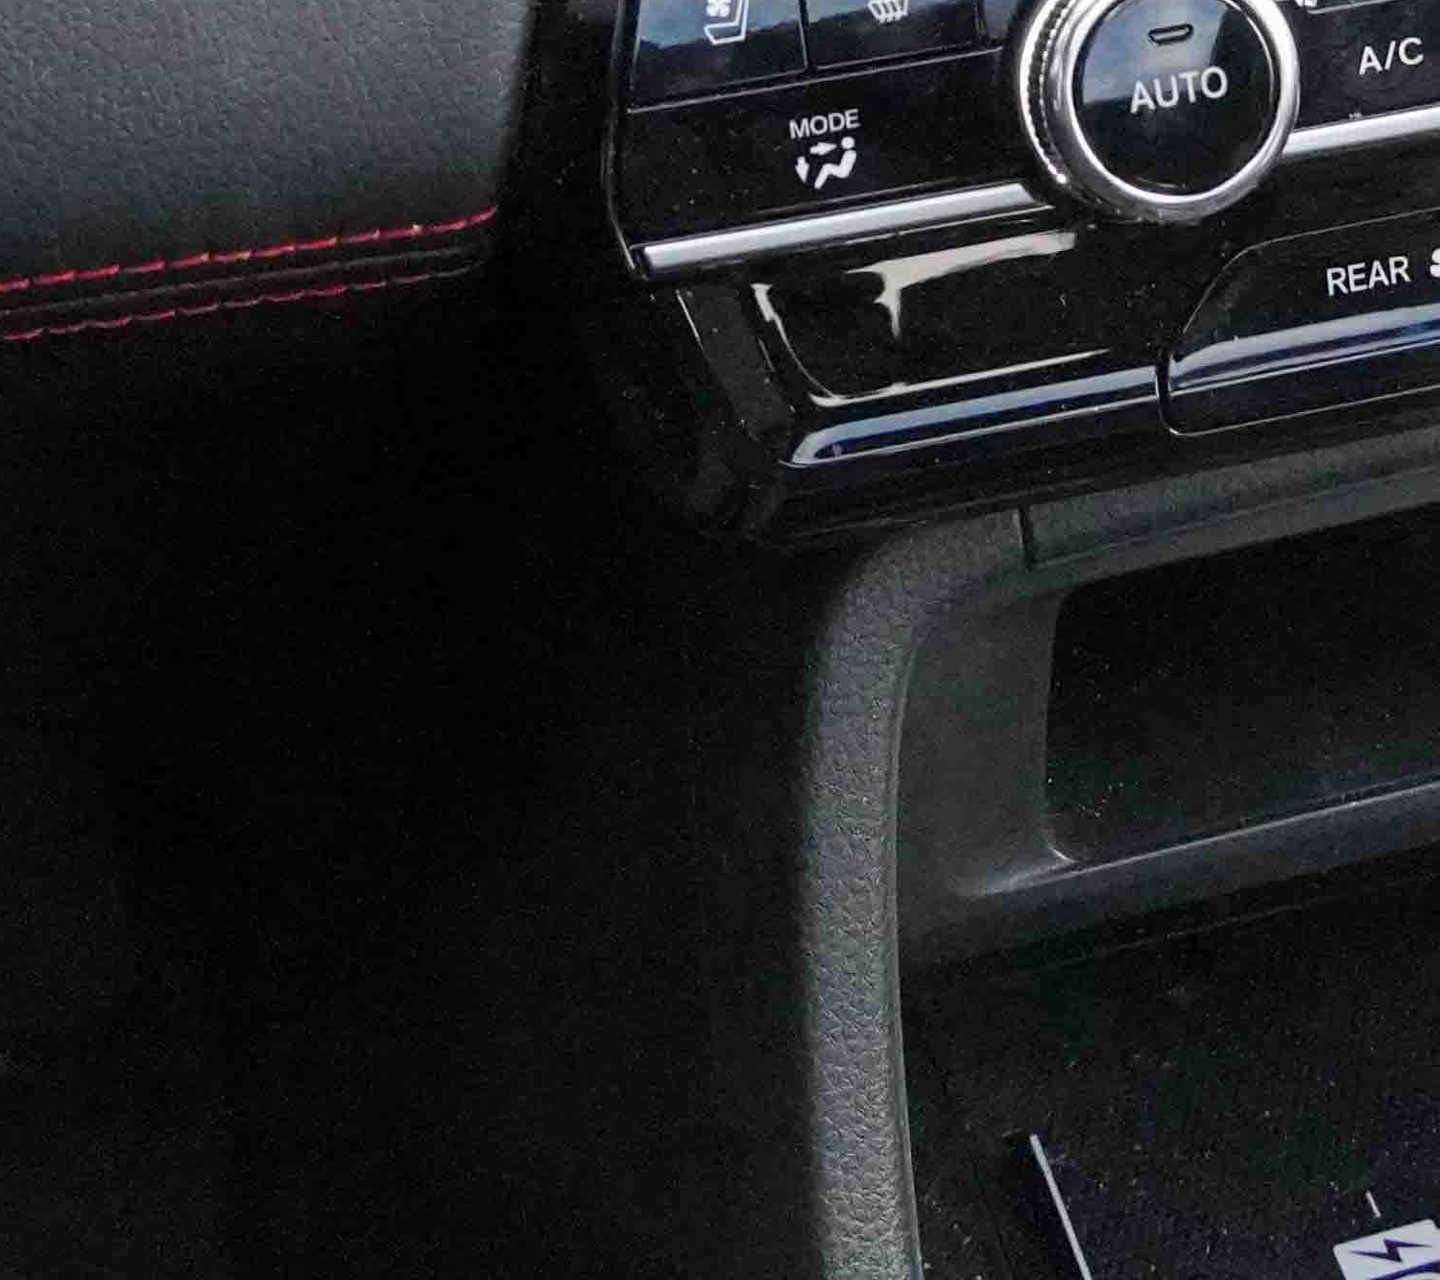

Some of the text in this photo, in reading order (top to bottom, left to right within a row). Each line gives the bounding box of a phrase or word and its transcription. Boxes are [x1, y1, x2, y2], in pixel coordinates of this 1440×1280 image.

[1359, 37, 1424, 76] A/C
[1129, 66, 1228, 115] AUTO
[789, 108, 860, 140] MODE
[1326, 256, 1410, 296] REAR
